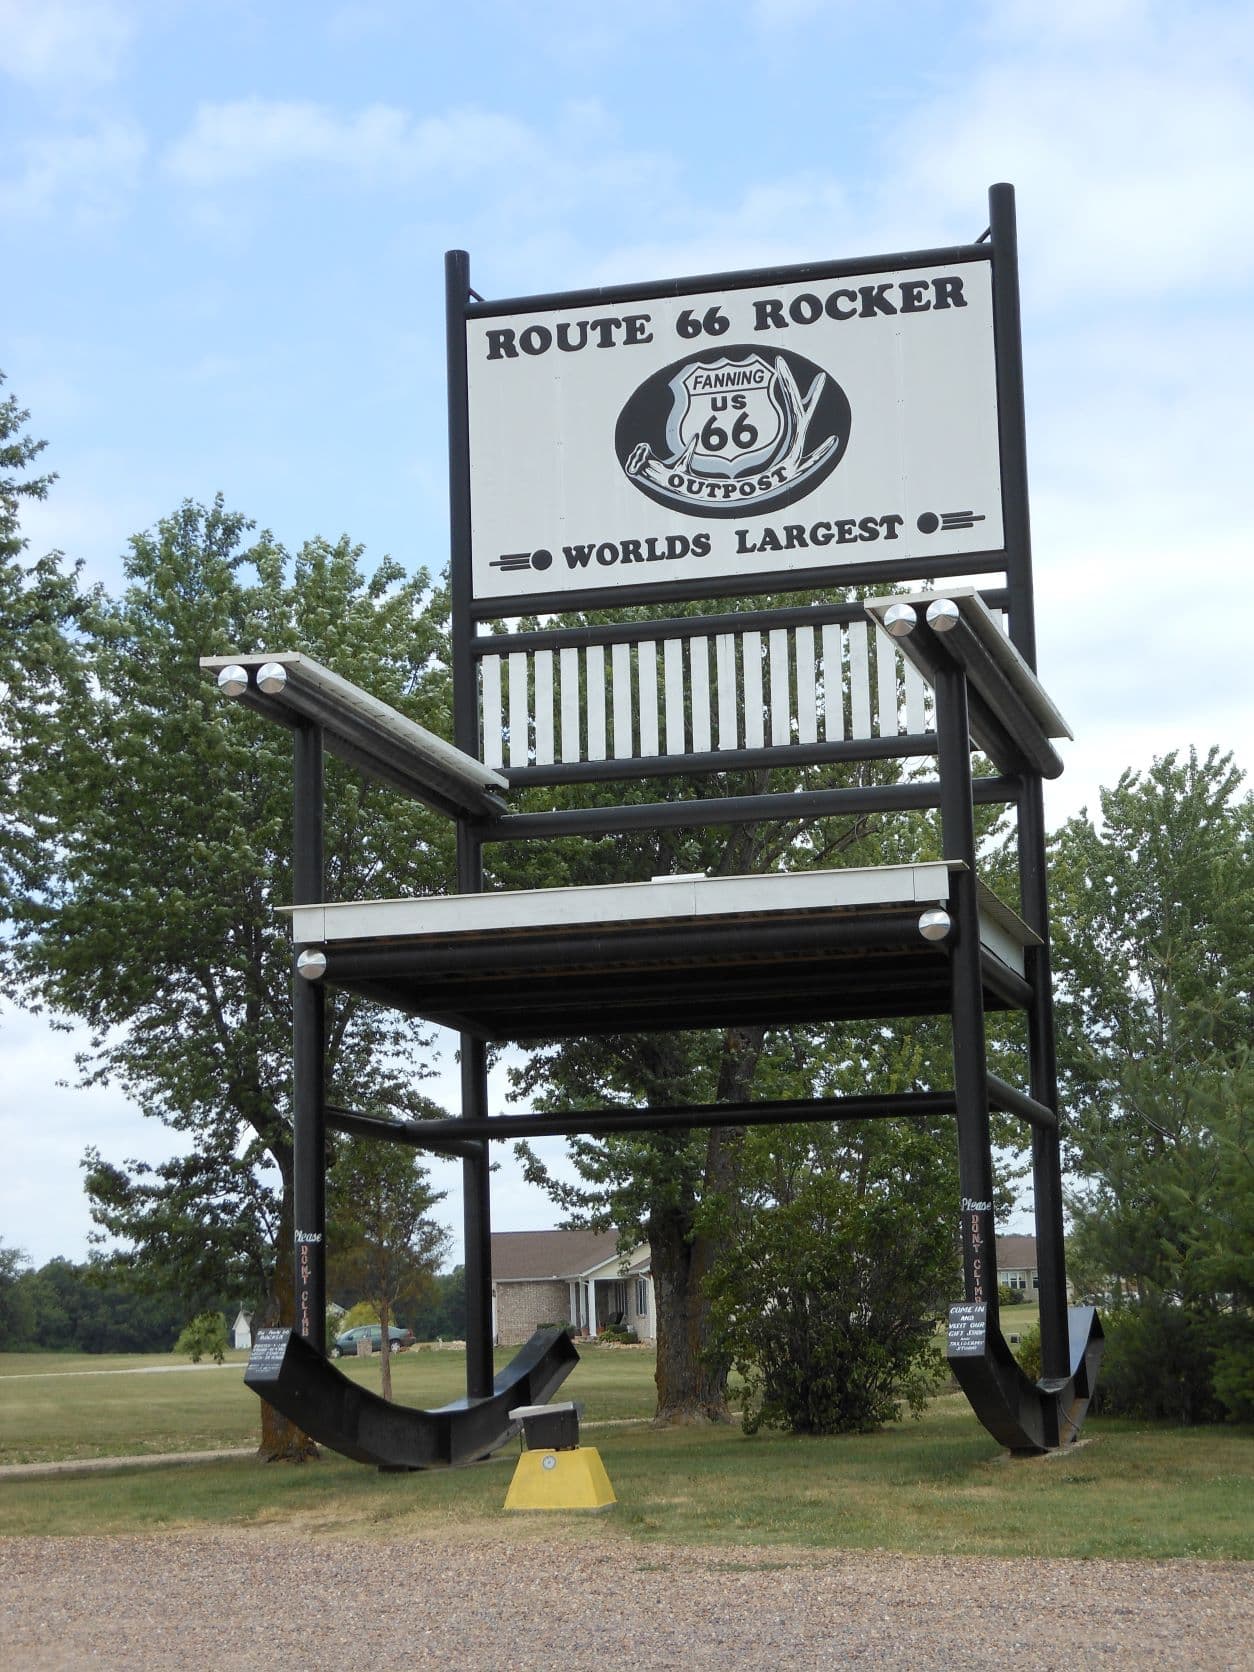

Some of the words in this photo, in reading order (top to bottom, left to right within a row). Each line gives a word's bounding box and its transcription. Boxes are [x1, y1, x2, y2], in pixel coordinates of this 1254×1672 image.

[486, 314, 654, 360] ROUTE
[675, 306, 730, 339] 66
[752, 276, 968, 332] ROCKER
[693, 369, 765, 390] FANNING
[711, 394, 747, 412] US
[700, 411, 759, 451] 66
[667, 466, 788, 498] OUTPOST
[562, 533, 712, 569] WORLDS
[734, 514, 904, 554] LARGEST
[961, 1198, 992, 1211] Please
[294, 1229, 322, 1243] Please
[950, 1306, 974, 1314] COME
[969, 1321, 985, 1329] OUR
